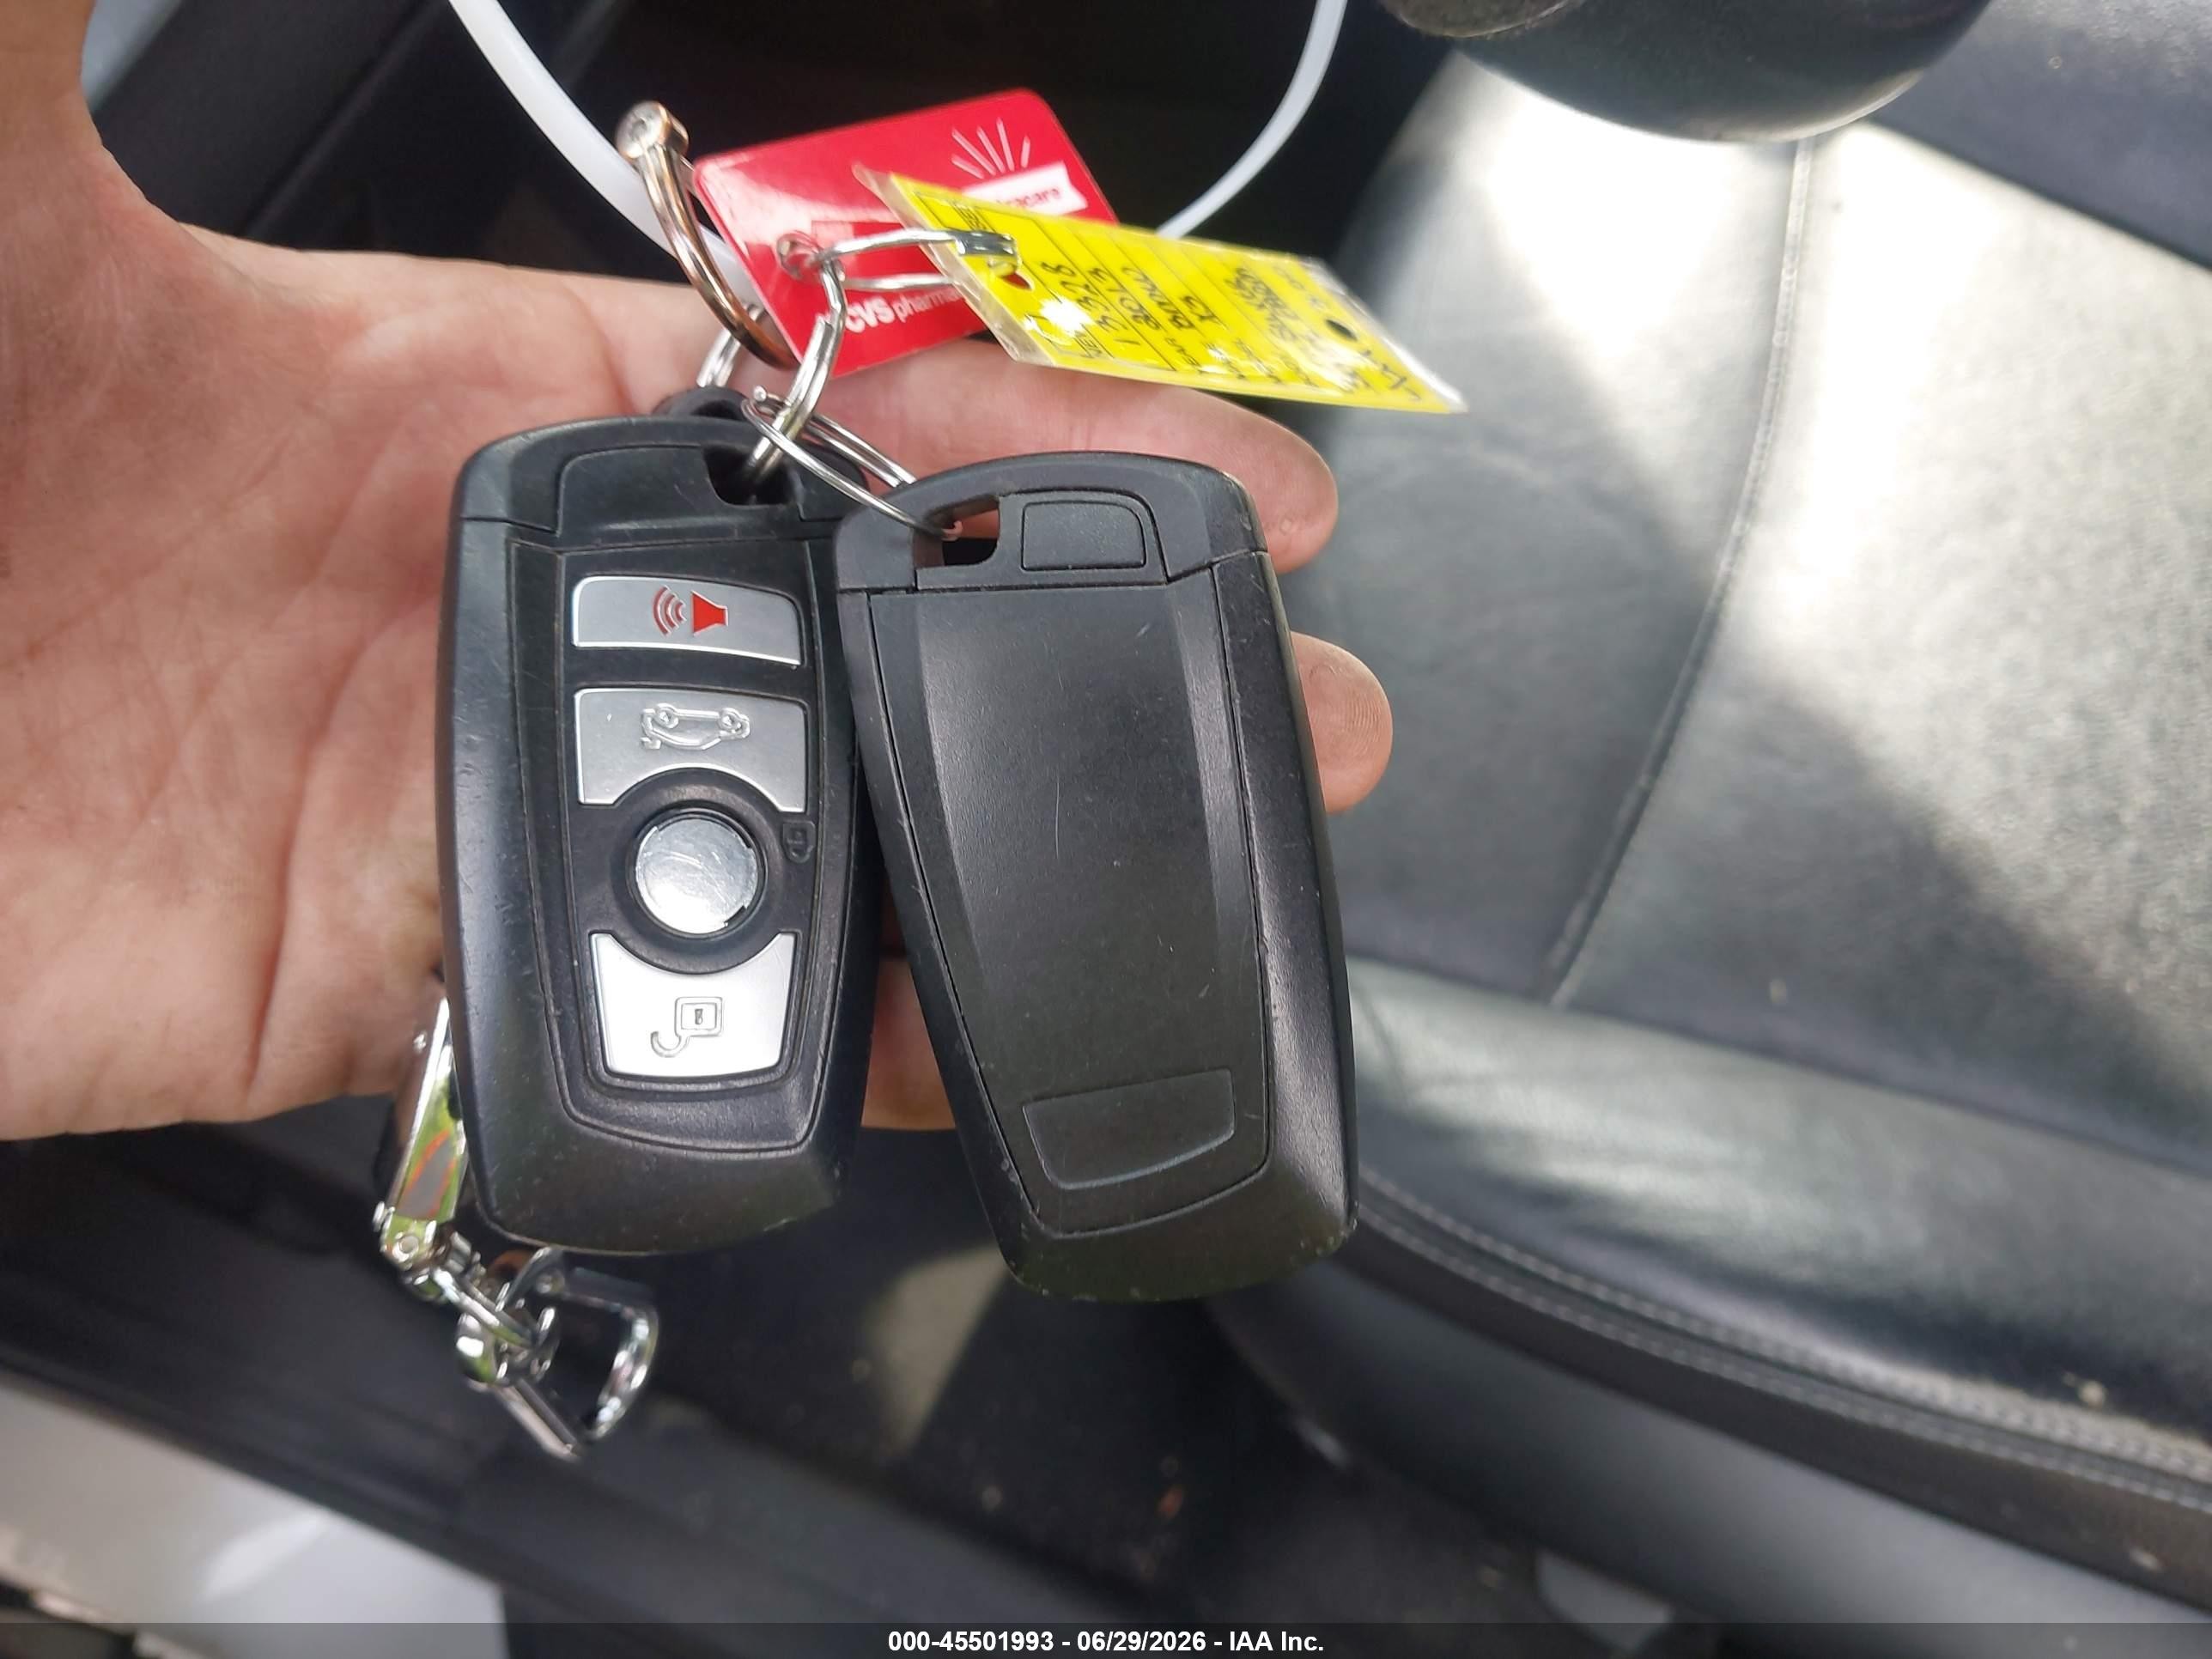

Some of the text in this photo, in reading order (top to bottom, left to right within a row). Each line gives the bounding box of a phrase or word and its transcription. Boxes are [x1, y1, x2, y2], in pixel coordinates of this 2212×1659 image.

[845, 295, 896, 333] CVS
[1041, 262, 1140, 344] 13328
[1088, 266, 1210, 374] YEAR 2013
[1179, 295, 1217, 321] X3
